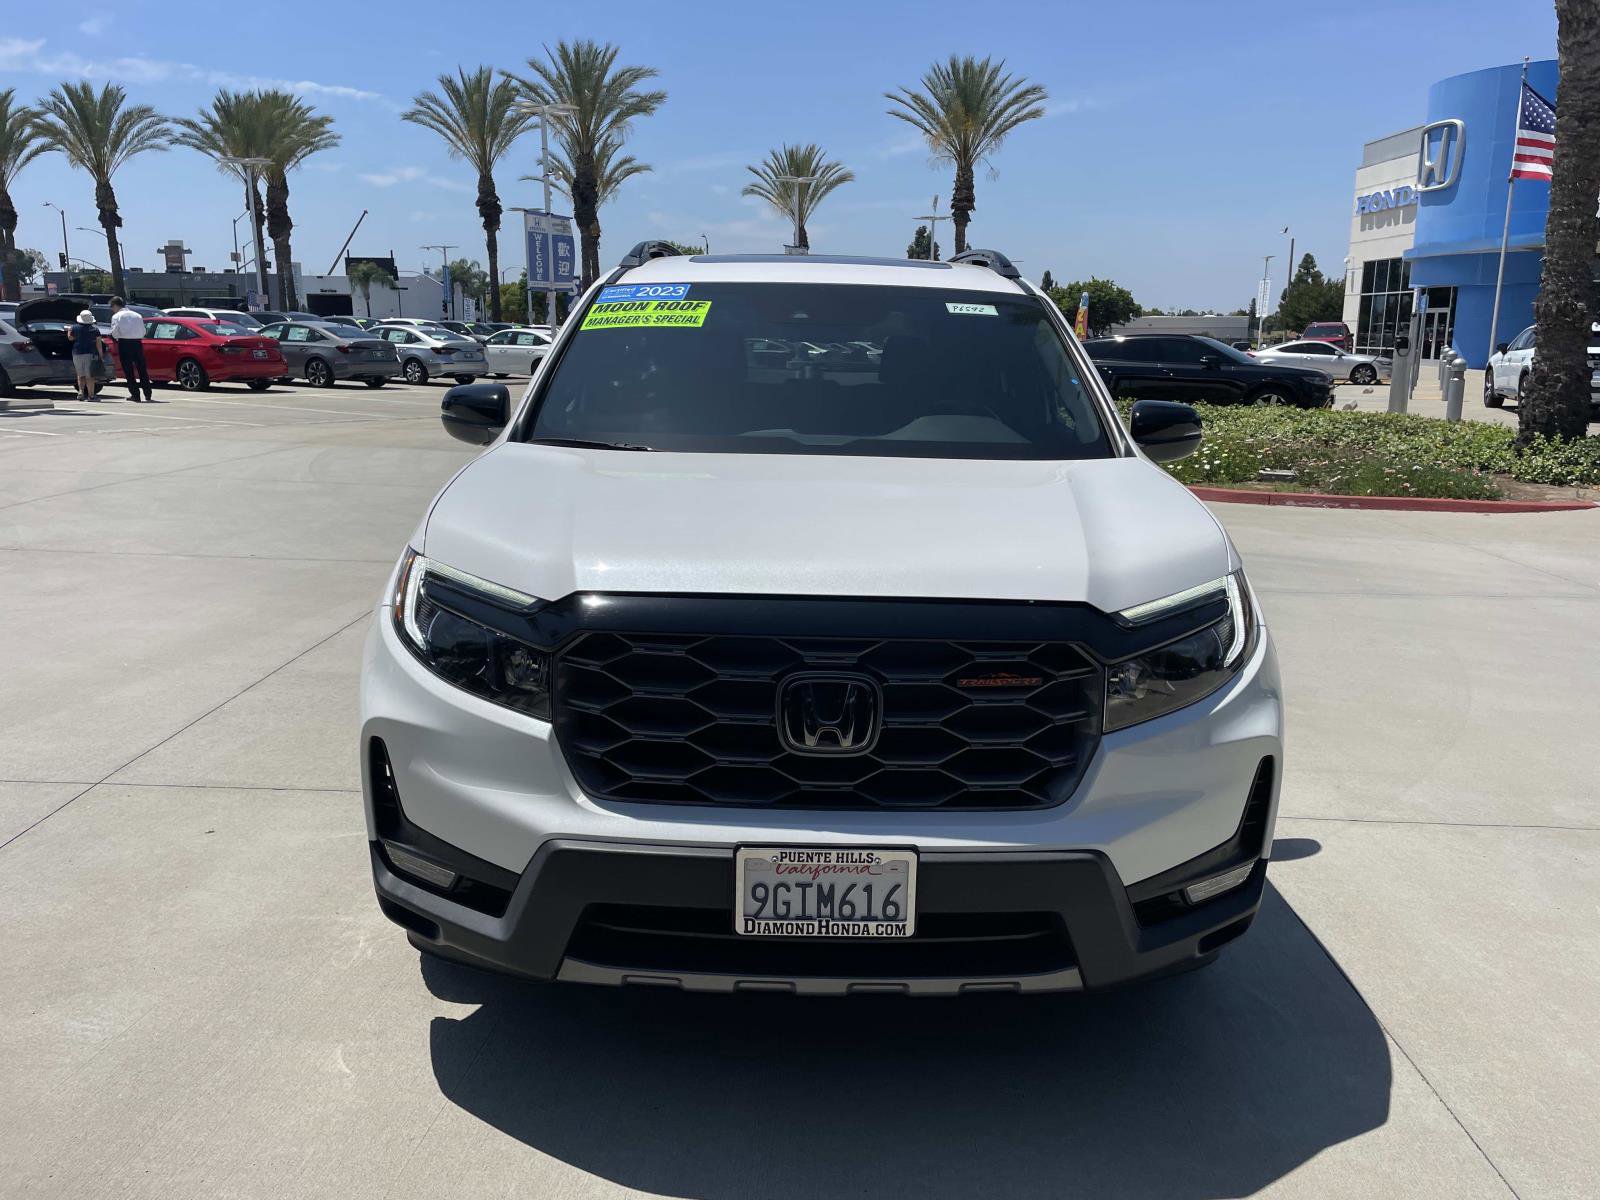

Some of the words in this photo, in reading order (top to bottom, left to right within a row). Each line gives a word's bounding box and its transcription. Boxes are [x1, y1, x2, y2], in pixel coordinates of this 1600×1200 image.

[533, 233, 544, 281] WELCOME
[636, 286, 685, 297] 2023
[592, 301, 650, 314] MOON
[653, 301, 707, 312] ROOF
[586, 314, 652, 327] MANAGER'S
[653, 314, 701, 324] SPECIAL
[779, 851, 832, 864] PUENTE
[835, 852, 874, 864] HILLS
[775, 863, 883, 881] California
[750, 882, 902, 921] 9GIM616
